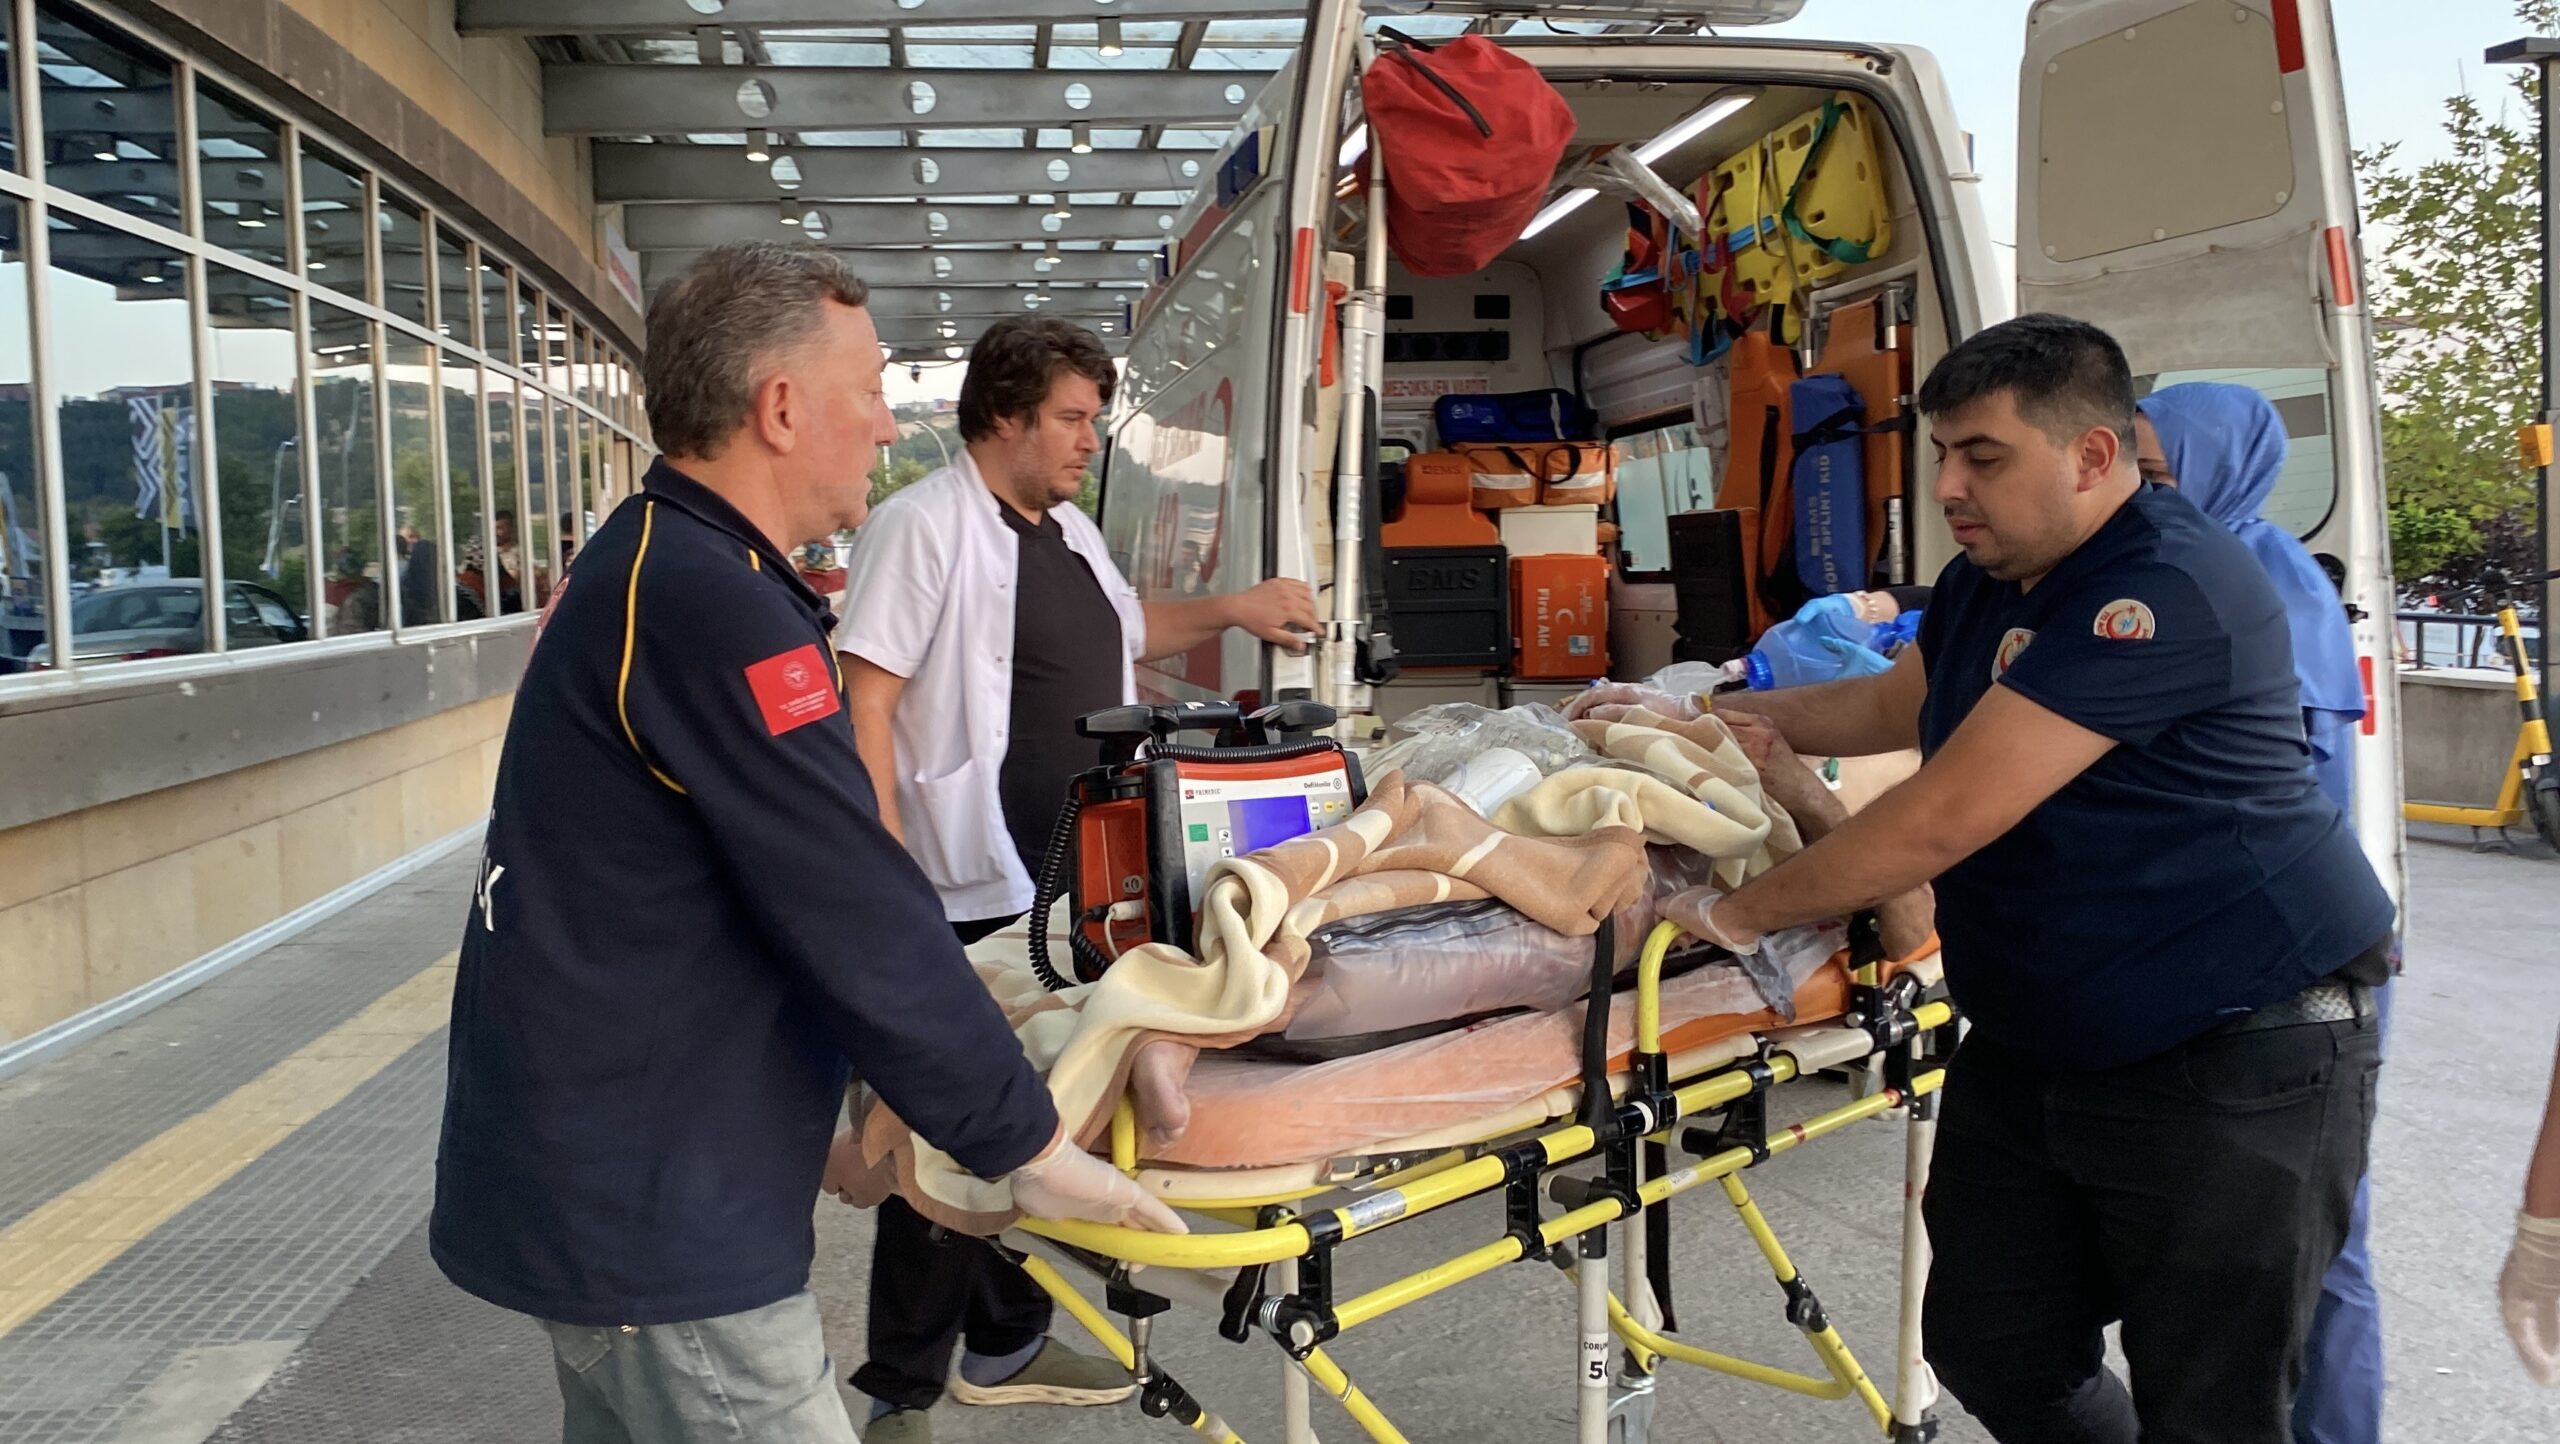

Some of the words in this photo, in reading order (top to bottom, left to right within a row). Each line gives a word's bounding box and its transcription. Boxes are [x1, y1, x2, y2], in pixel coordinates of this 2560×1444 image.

[1819, 455, 1830, 483] KID
[1820, 490, 1831, 545] SPLINT
[1407, 567, 1480, 590] EMS
[1537, 588, 1550, 620] First
[1537, 624, 1550, 647] Aid
